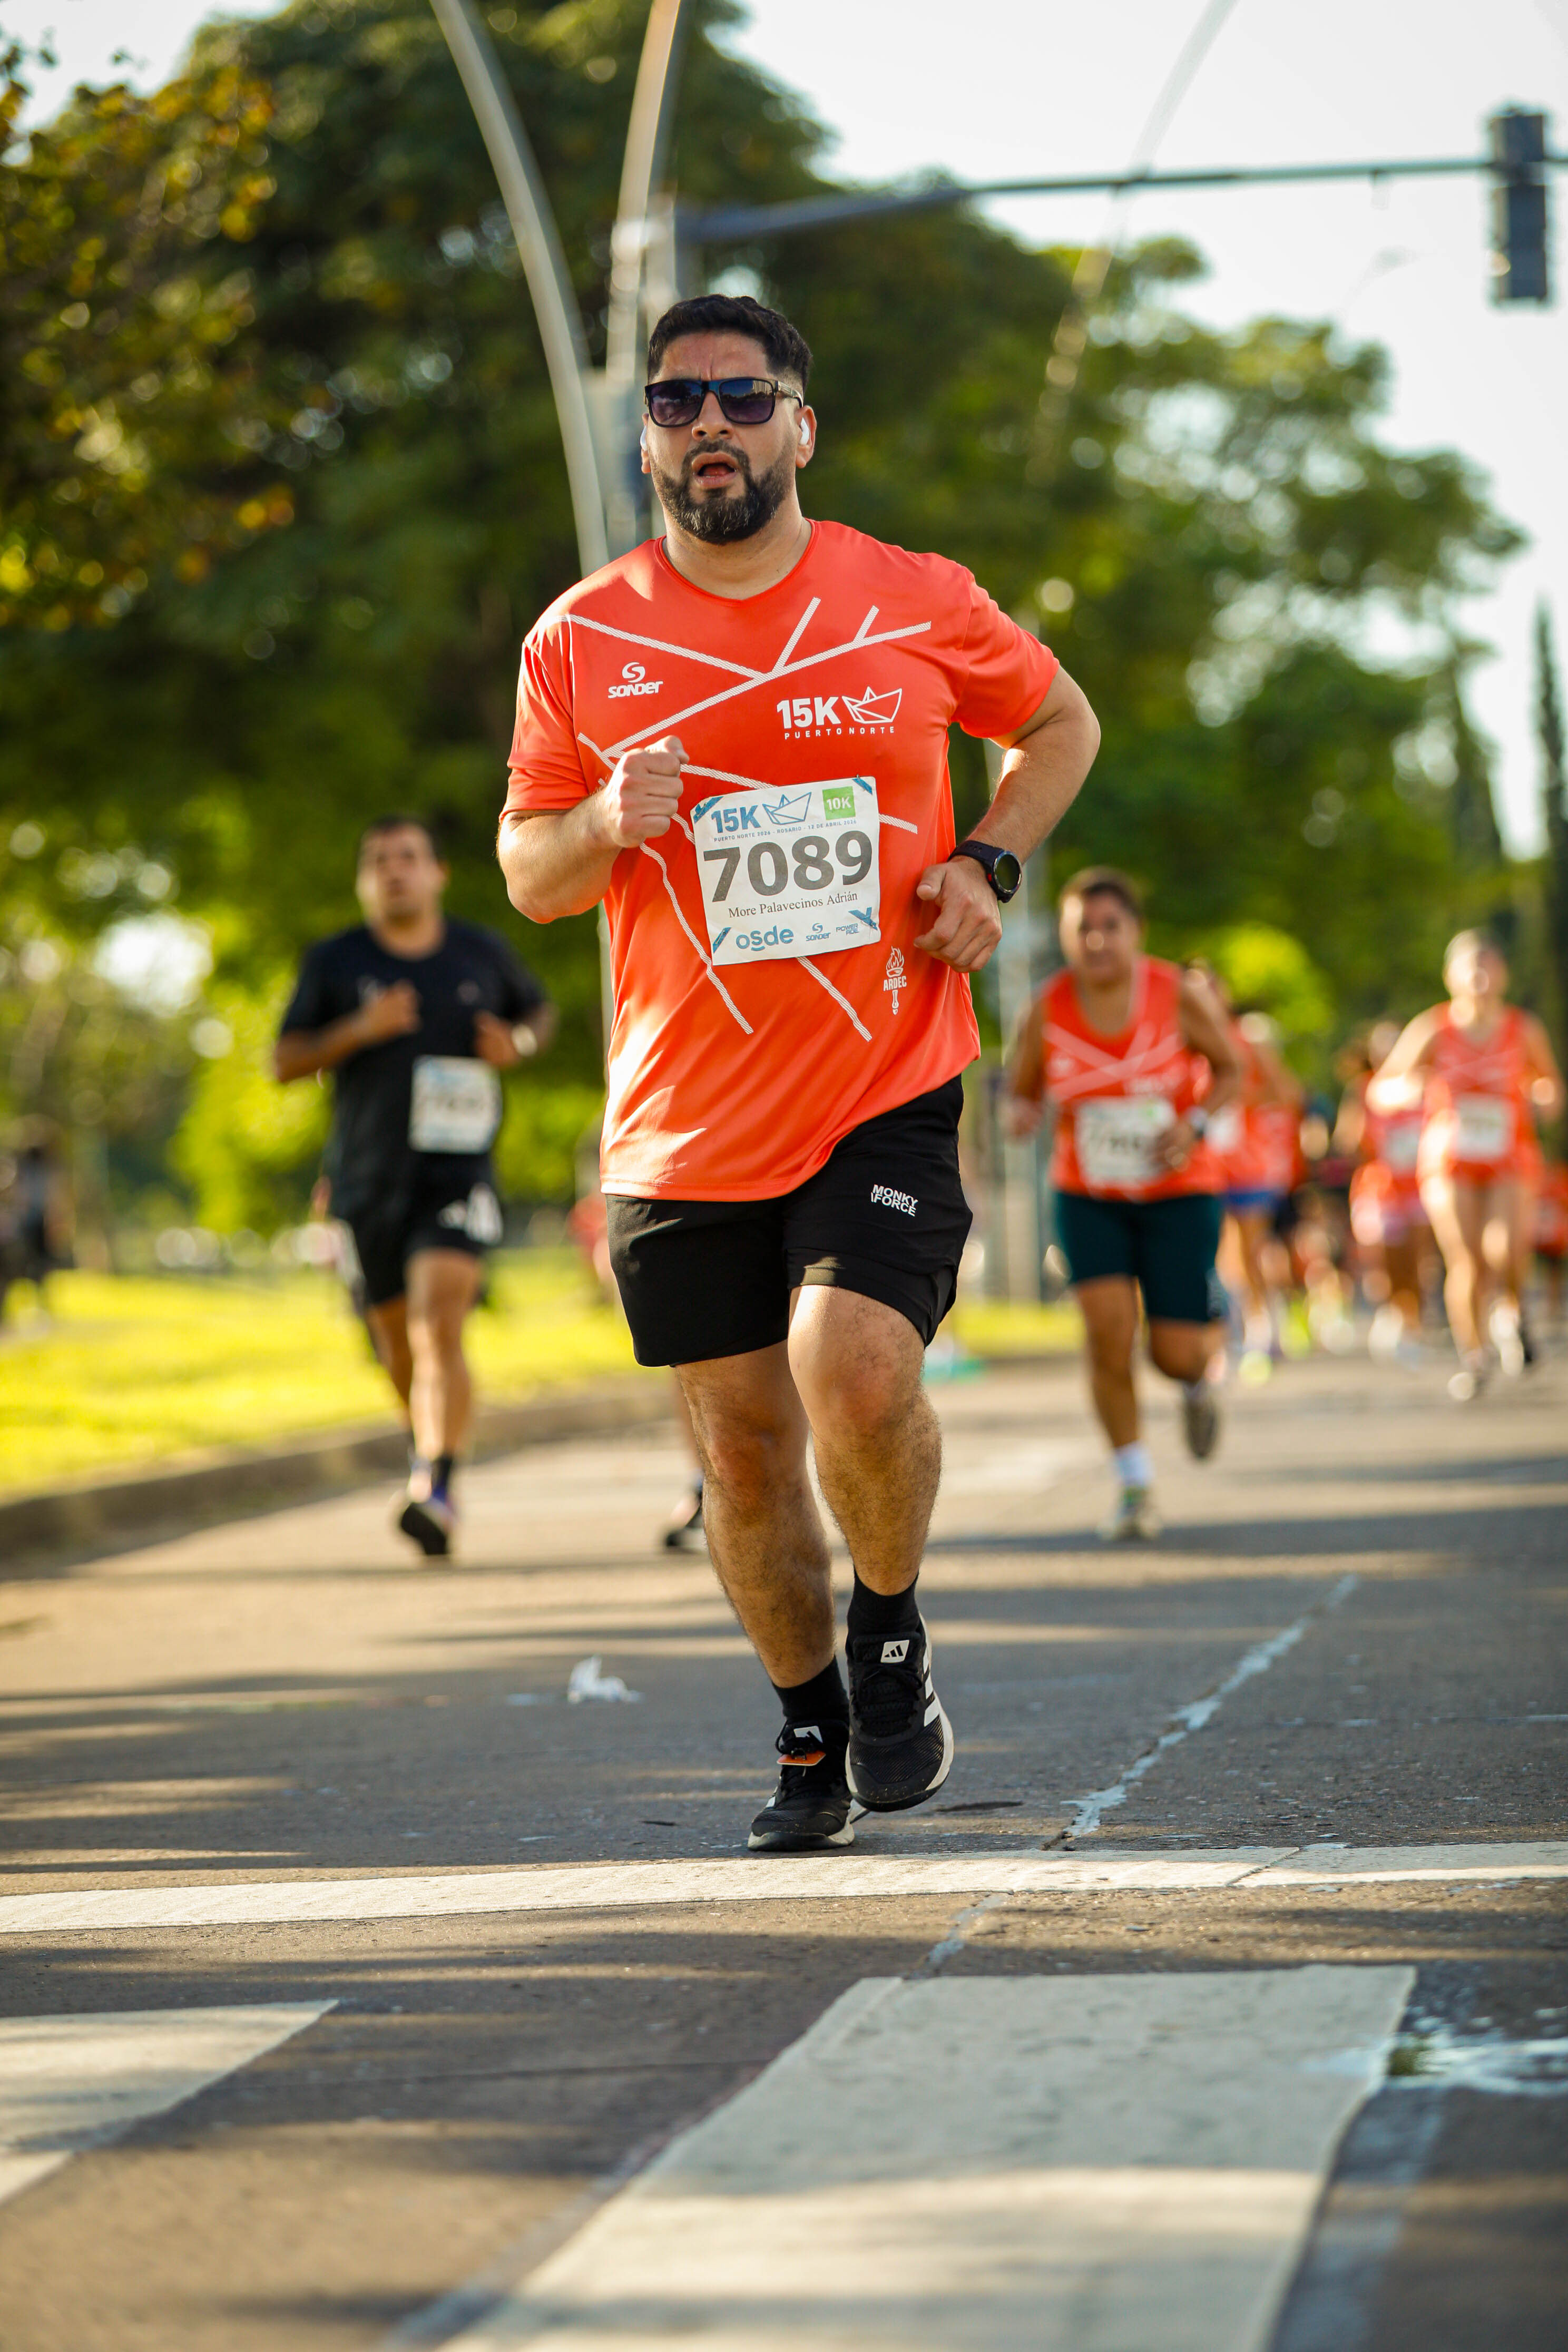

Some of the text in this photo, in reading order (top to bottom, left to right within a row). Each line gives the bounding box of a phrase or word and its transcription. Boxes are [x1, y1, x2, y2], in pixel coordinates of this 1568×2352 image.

[777, 696, 841, 729] 15K
[785, 726, 894, 740] PUERTO NORTE
[826, 796, 853, 811] 10K
[711, 805, 761, 834] 15K
[703, 830, 873, 903] 7089
[728, 891, 858, 918] More Palavecinos Adrián
[736, 925, 794, 950] osde
[836, 923, 858, 932] POWER
[883, 975, 907, 992] ARDEC
[872, 1184, 918, 1207] MONKY
